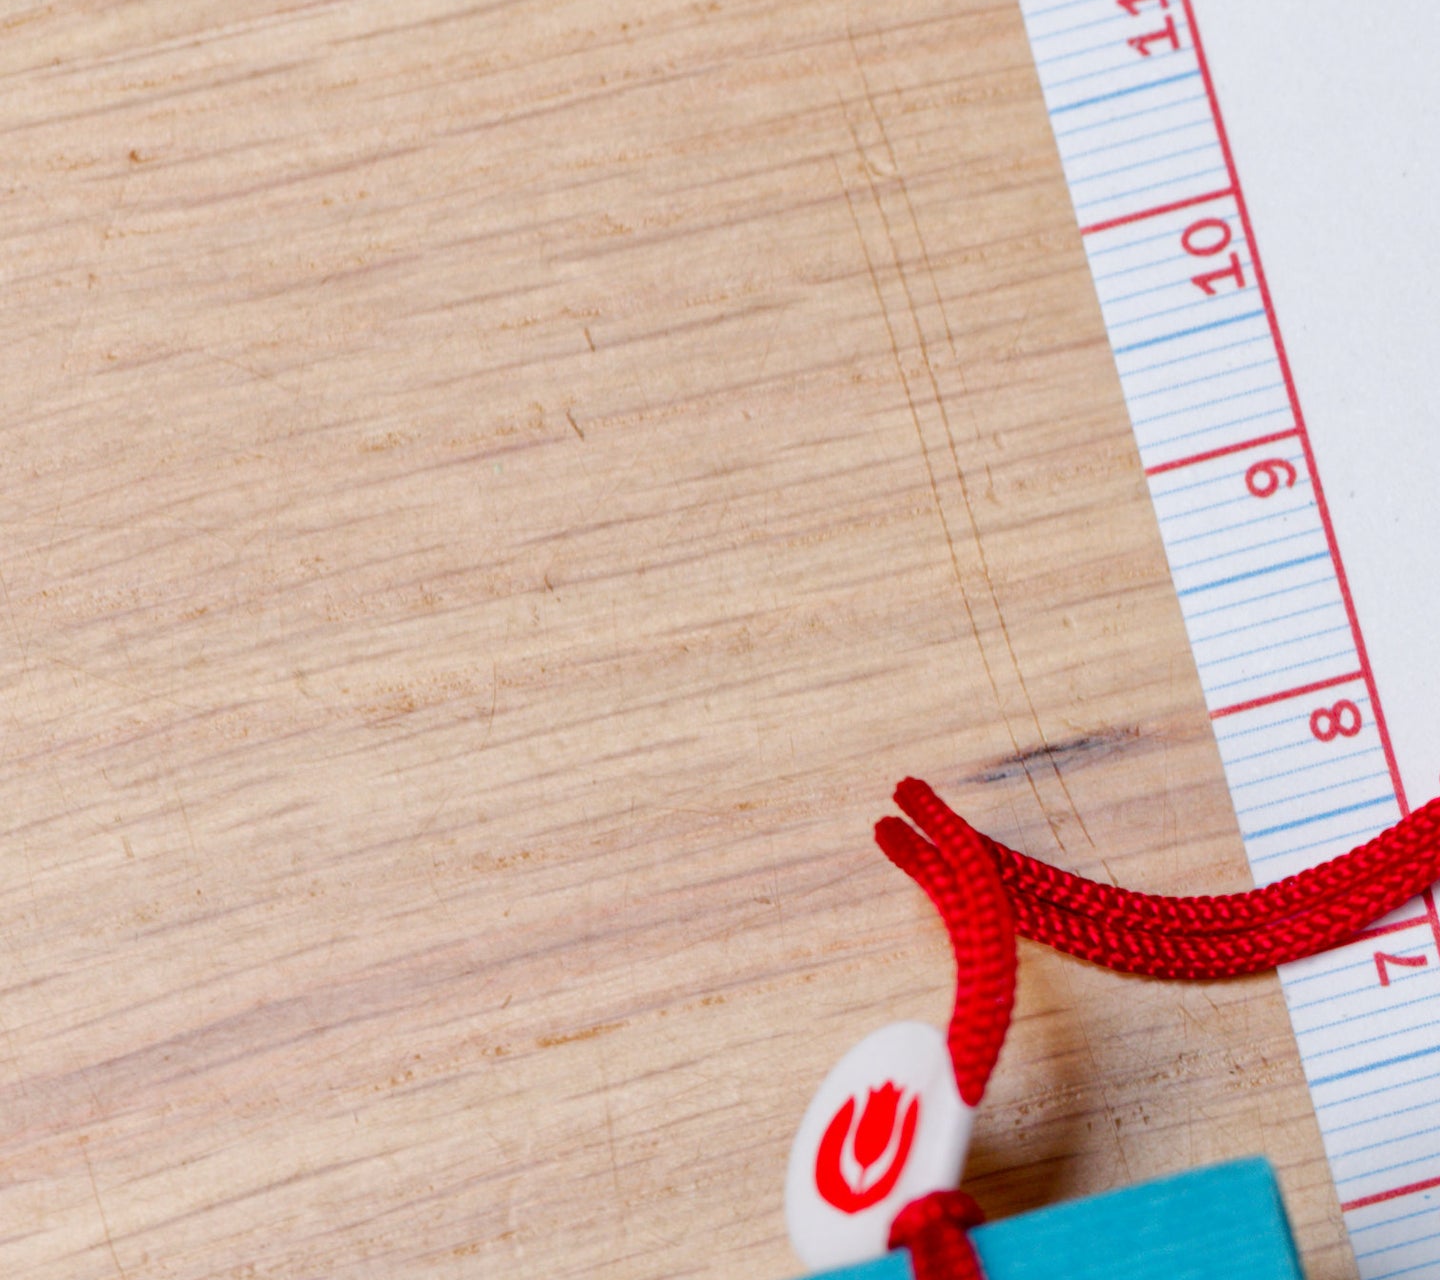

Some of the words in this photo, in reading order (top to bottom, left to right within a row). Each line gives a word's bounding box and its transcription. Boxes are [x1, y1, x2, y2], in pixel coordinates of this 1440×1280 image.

[1180, 214, 1248, 296] 10
[1245, 455, 1297, 501] 9
[1309, 697, 1363, 745] 8
[1374, 948, 1429, 990] 7
